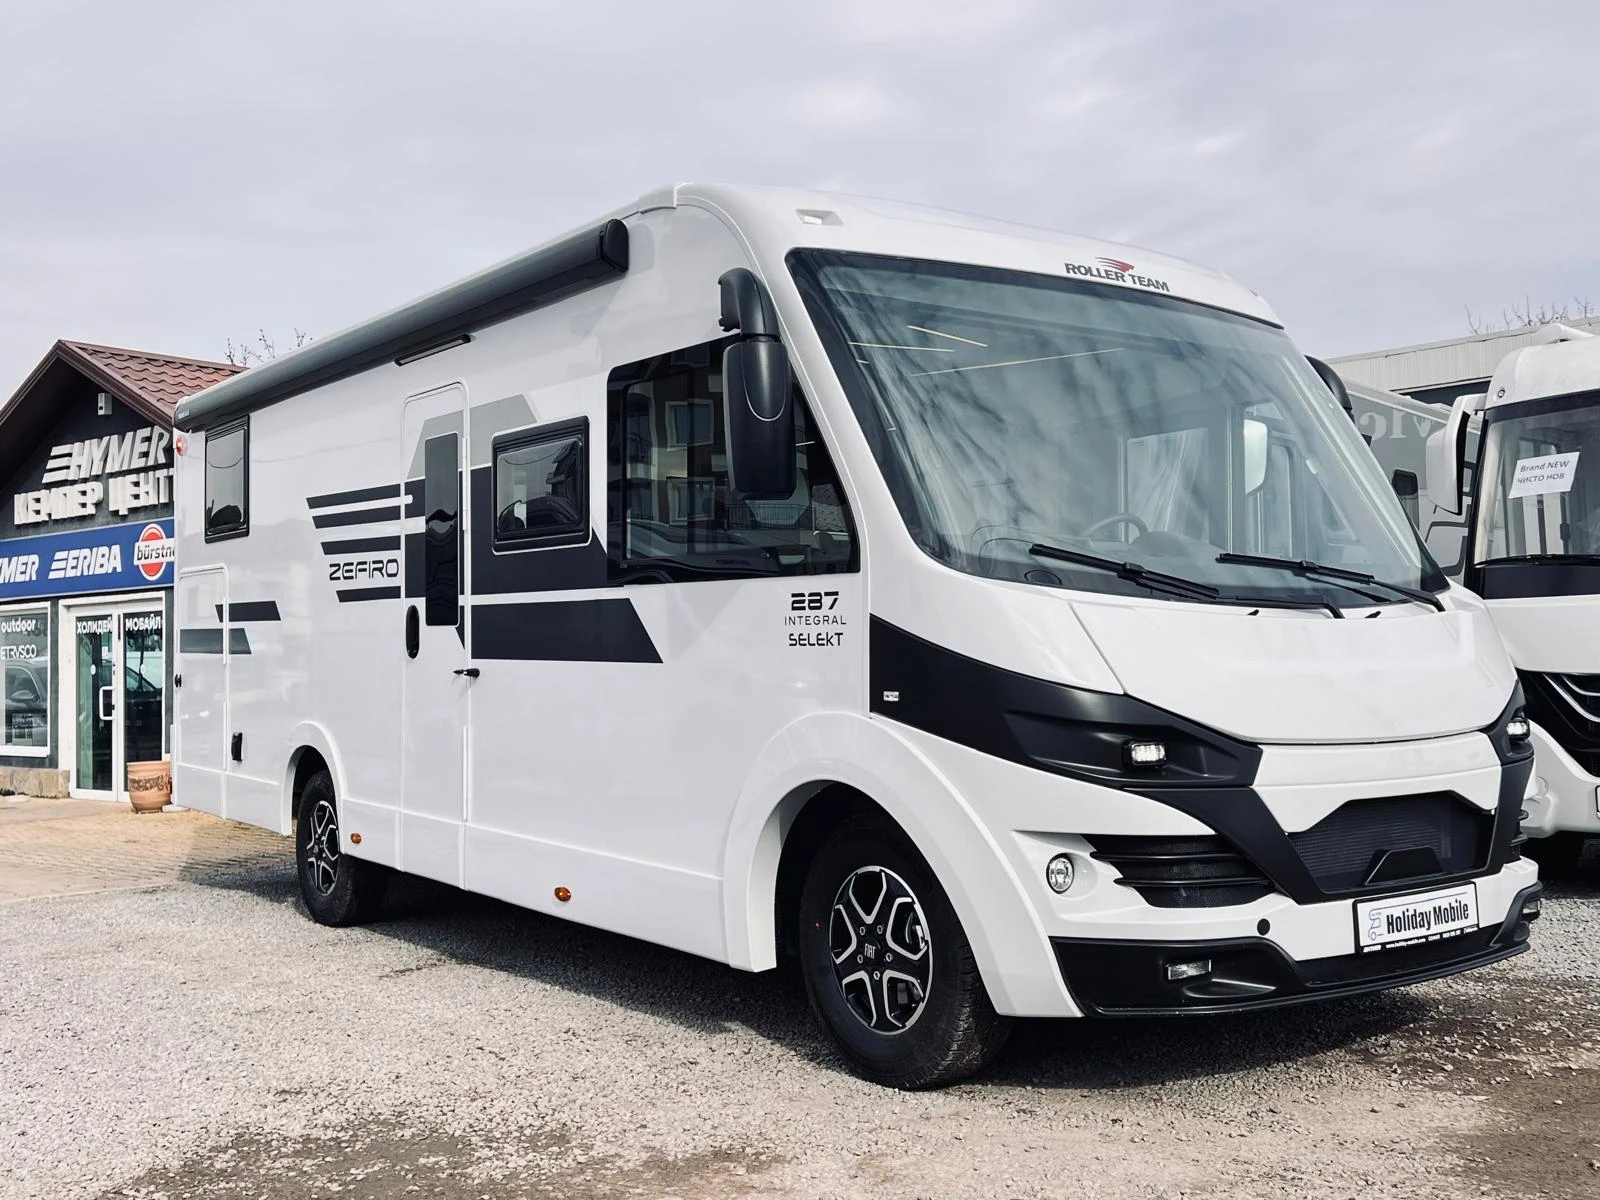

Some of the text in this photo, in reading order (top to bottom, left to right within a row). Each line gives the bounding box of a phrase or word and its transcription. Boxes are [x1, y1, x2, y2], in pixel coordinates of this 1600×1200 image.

[1064, 262, 1170, 293] ROLLER TEAM
[66, 425, 170, 481] HYMER
[1520, 460, 1570, 473] Brand NEW
[1517, 474, 1545, 484] ЧИСТО
[14, 467, 174, 525] КЕМПЕР ЦЕНТ
[0, 554, 39, 584] MER
[64, 544, 122, 578] ERIBA
[329, 558, 399, 581] ZEFIRO
[791, 591, 839, 611] 287
[1, 616, 36, 633] outdoor
[77, 613, 161, 635] ХОЛИДЕЙ МОБАЙЛ
[784, 615, 847, 626] INTEGRAL
[1386, 908, 1431, 934] Holiday
[1432, 899, 1469, 926] Mobile
[864, 943, 876, 959] FIAT
